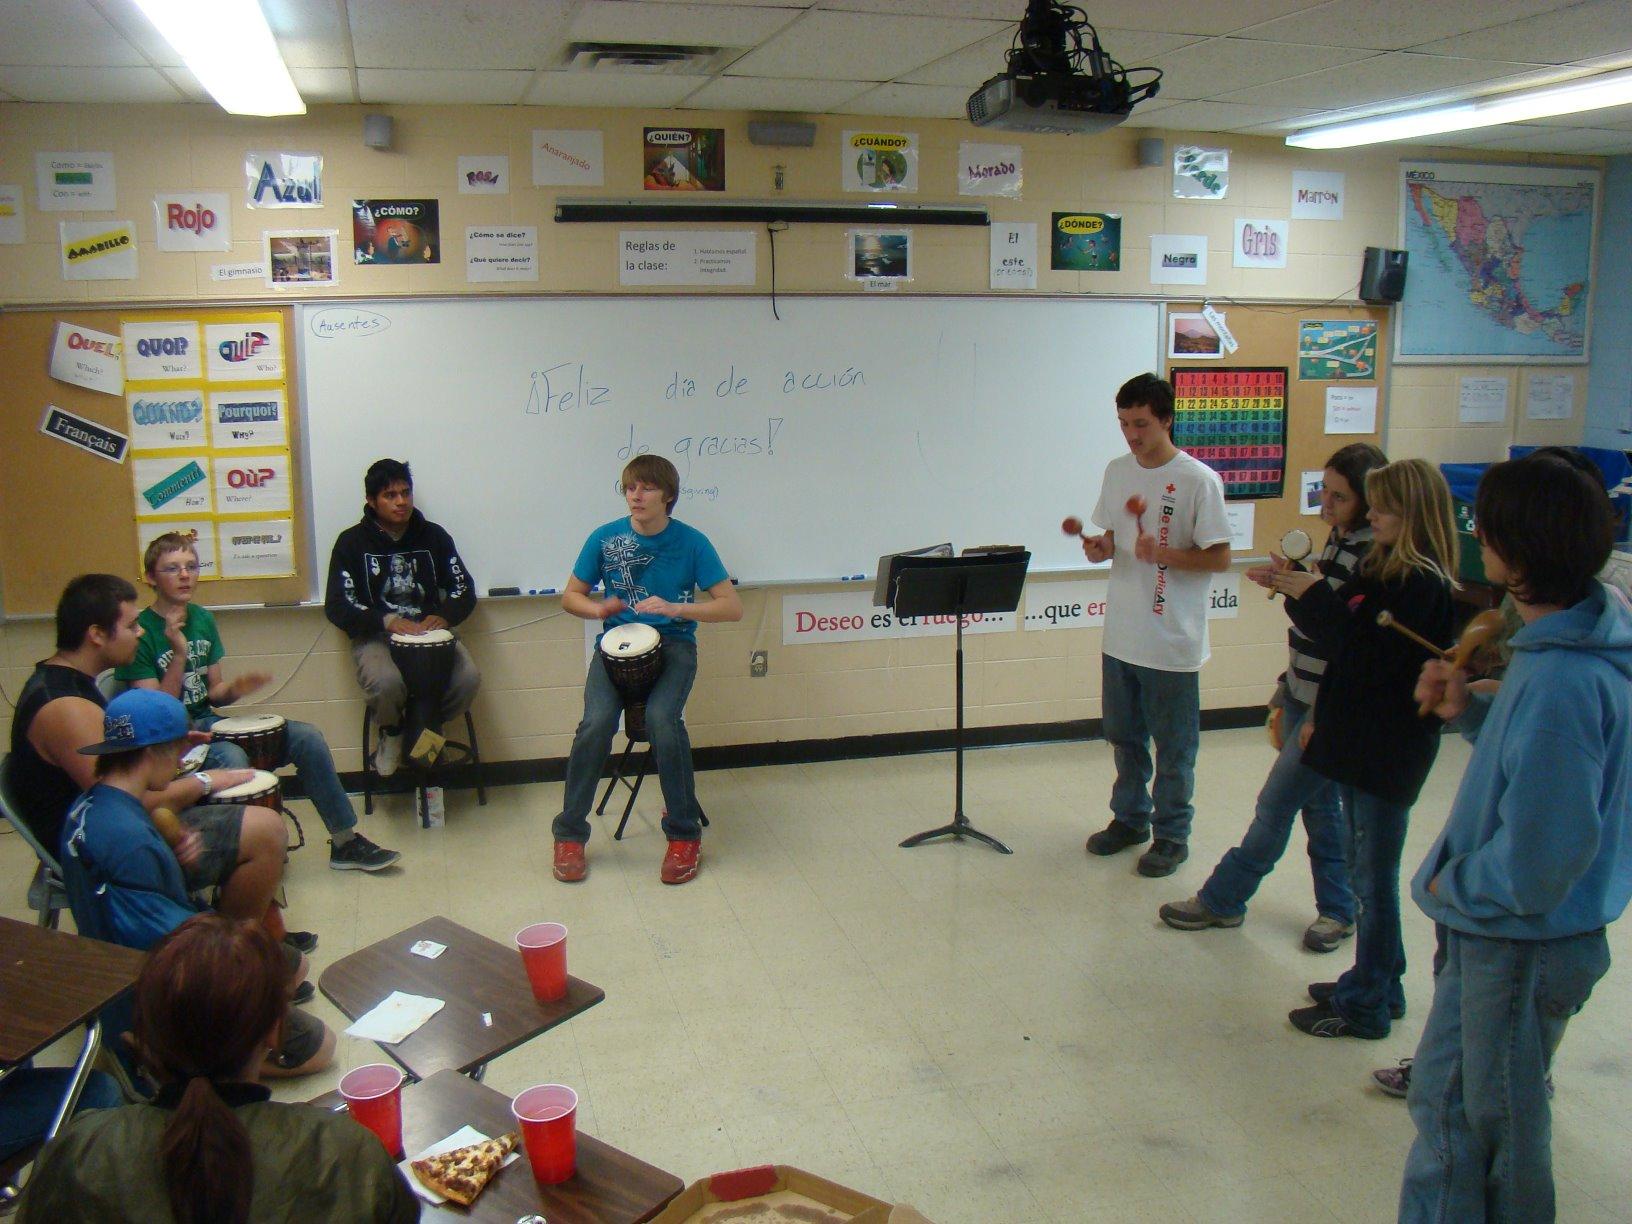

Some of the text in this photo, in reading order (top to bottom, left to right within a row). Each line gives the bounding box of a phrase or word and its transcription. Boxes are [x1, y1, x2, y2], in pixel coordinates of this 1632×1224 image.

[649, 132, 691, 143] ¿QUIÉN?
[854, 137, 907, 147] ¿CUÁNDO?
[542, 142, 591, 172] Anaranjado
[968, 162, 1016, 180] Morado
[254, 161, 320, 203] Azul
[167, 203, 216, 236] Rojo
[374, 206, 420, 218] ¿CÓMO?
[1058, 218, 1104, 230] ¿DÓNDE?
[1008, 232, 1019, 244] El
[1242, 223, 1278, 256] Gris
[625, 241, 676, 253] Reglas de
[626, 260, 669, 271] la clase:
[1163, 254, 1197, 266] Negro
[219, 266, 263, 278] El gimnasio
[320, 315, 381, 333] Ausentes
[162, 364, 187, 373] What?
[257, 364, 277, 372] Who?
[525, 363, 612, 415] ¡Feliz
[716, 365, 751, 398] de
[1178, 386, 1185, 397] 11
[1189, 386, 1197, 397] 12
[1211, 386, 1219, 397] 14
[1244, 386, 1252, 397] 17
[1177, 398, 1185, 409] 21
[1188, 398, 1196, 409] 22
[1199, 398, 1207, 409] 23
[1210, 398, 1218, 409] 24
[1221, 398, 1229, 409] 25
[1242, 398, 1251, 409] 27
[1274, 398, 1282, 409] 30
[54, 416, 118, 453] Français
[674, 417, 784, 481] gracias!
[227, 467, 275, 489] Où?
[1208, 588, 1239, 609] ida
[1024, 602, 1082, 624] ...que
[795, 611, 864, 633] Deseo
[870, 613, 892, 628] es
